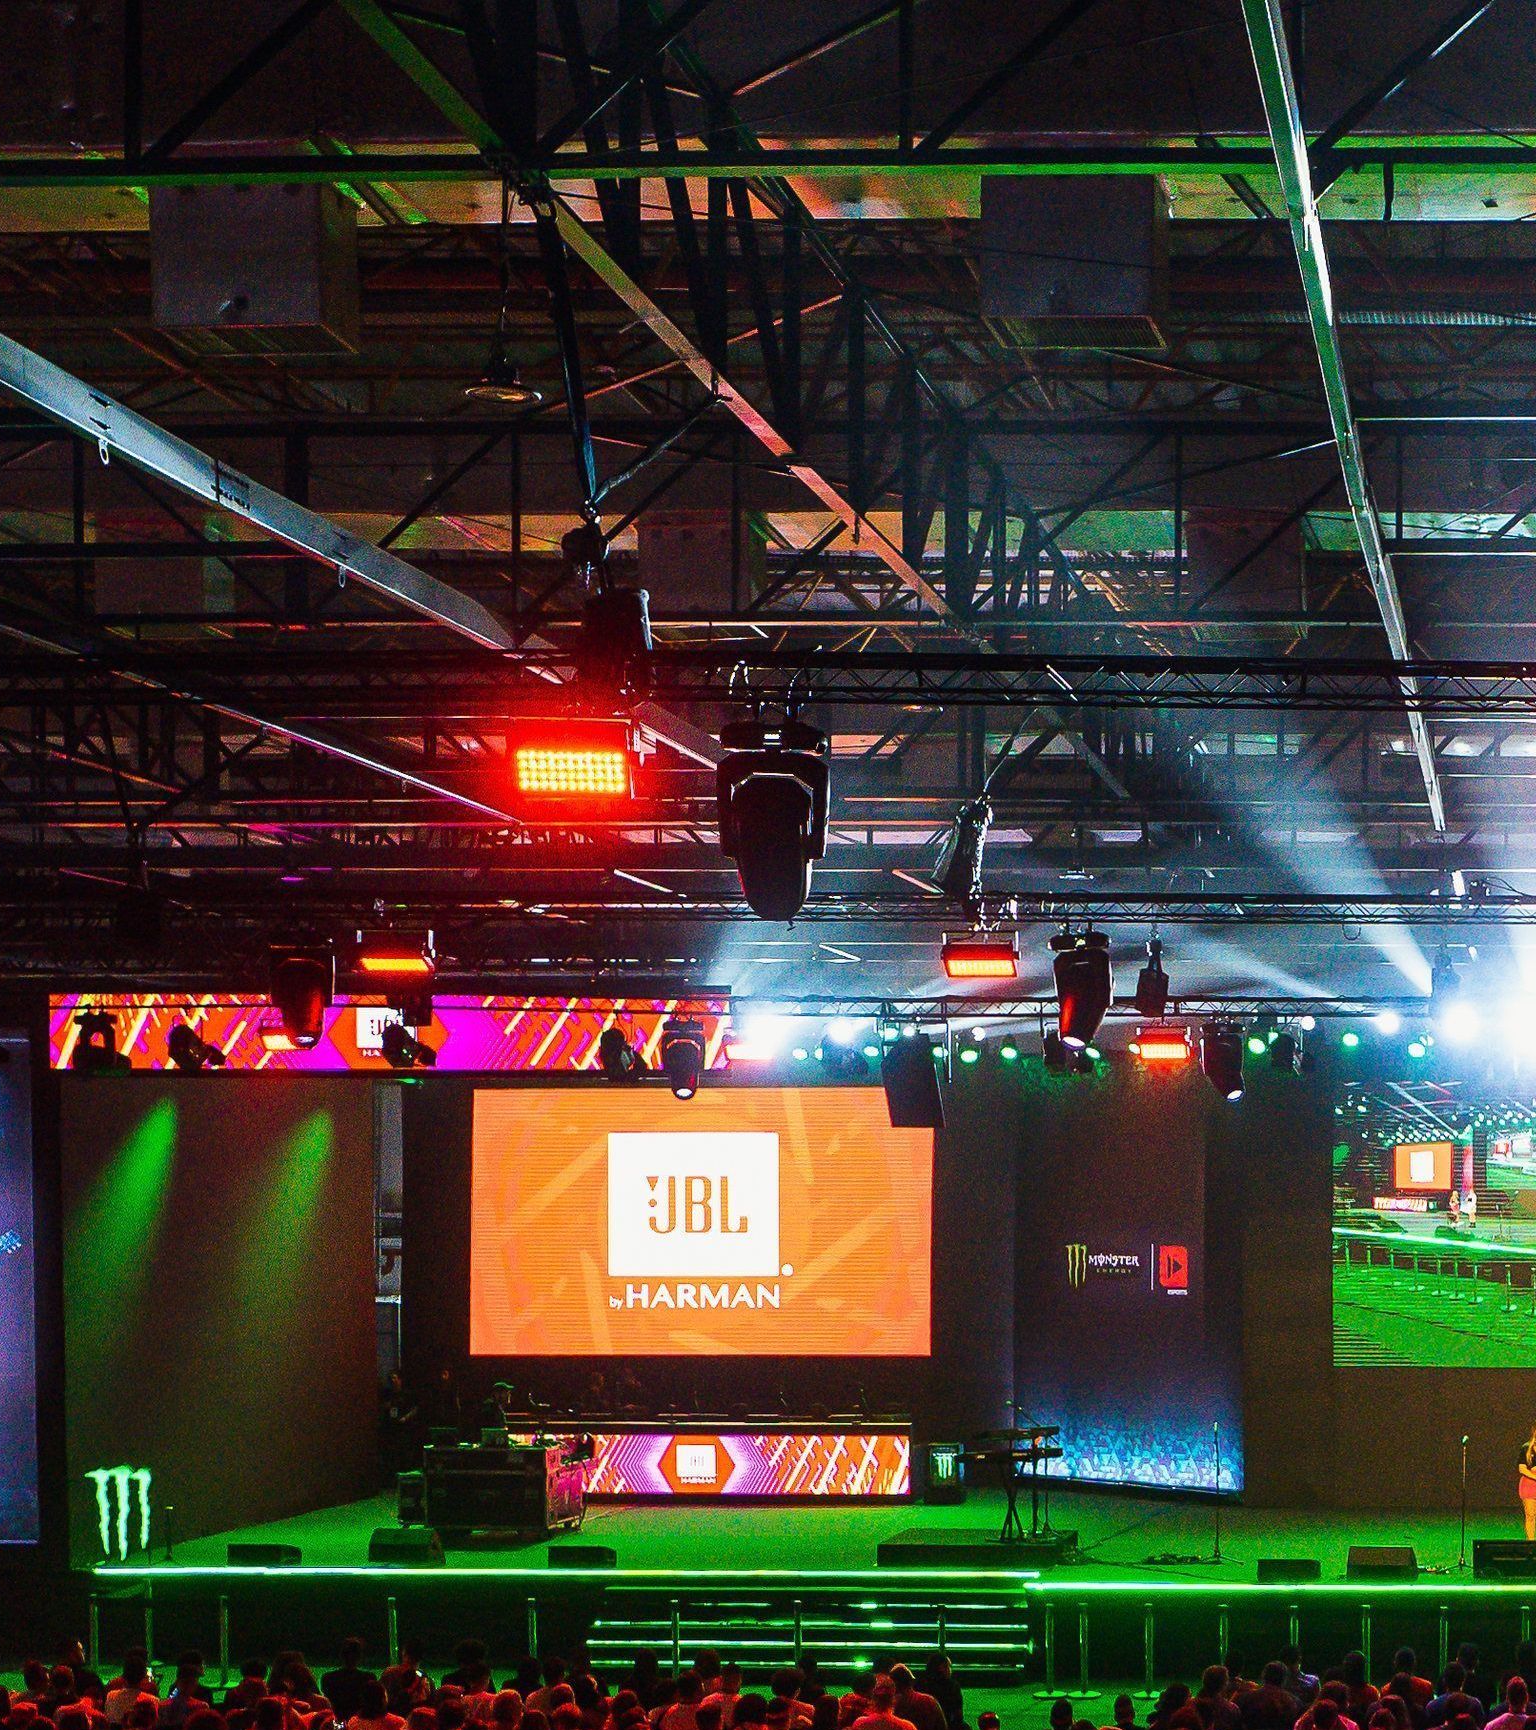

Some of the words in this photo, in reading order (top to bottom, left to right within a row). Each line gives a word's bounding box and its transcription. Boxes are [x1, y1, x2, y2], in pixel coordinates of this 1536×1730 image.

[646, 1175, 749, 1235] JBL
[1088, 1253, 1140, 1267] MONSTER
[609, 1296, 623, 1310] by
[626, 1283, 781, 1309] HARMAN
